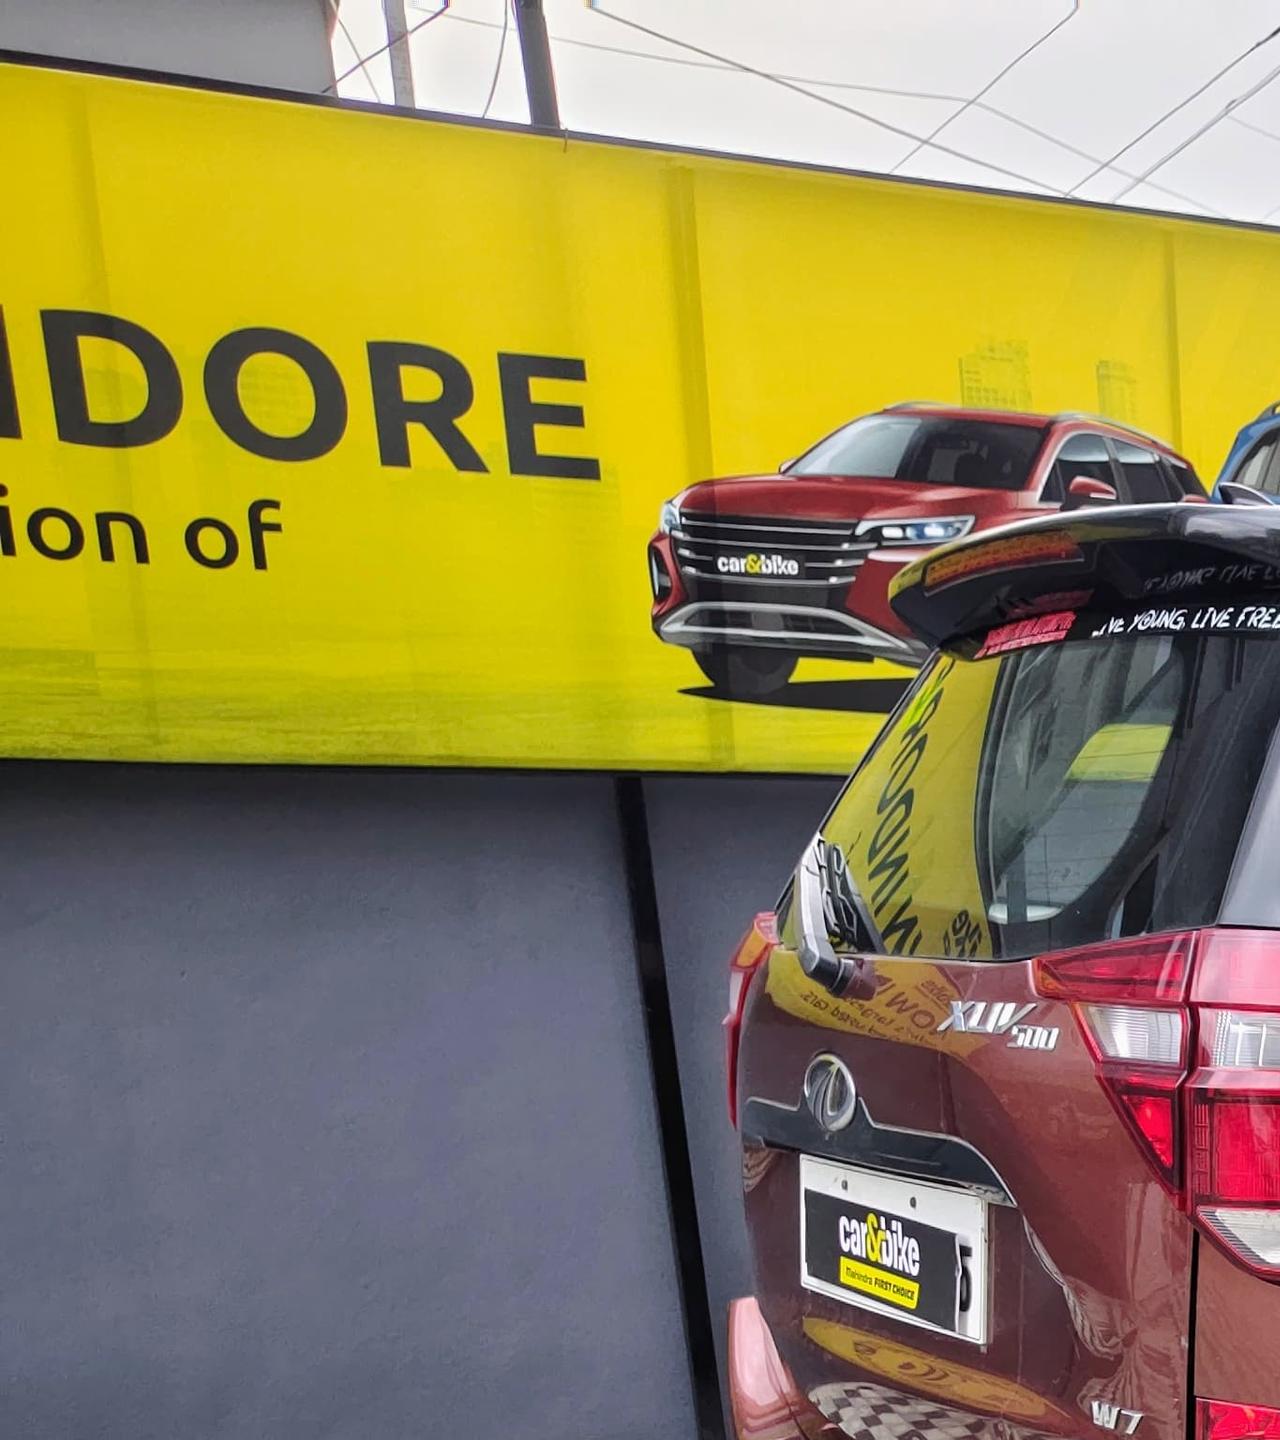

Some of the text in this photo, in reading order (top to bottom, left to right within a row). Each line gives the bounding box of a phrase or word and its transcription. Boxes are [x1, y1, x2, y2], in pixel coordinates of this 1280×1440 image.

[0, 303, 601, 480] DORE
[184, 499, 283, 571] of
[717, 554, 799, 576] car&bike
[1191, 607, 1234, 629] LIVE
[839, 1213, 921, 1277] car&bike
[874, 1277, 892, 1292] FIRST
[892, 1283, 915, 1301] CHOICE
[1091, 1401, 1144, 1435] W7
